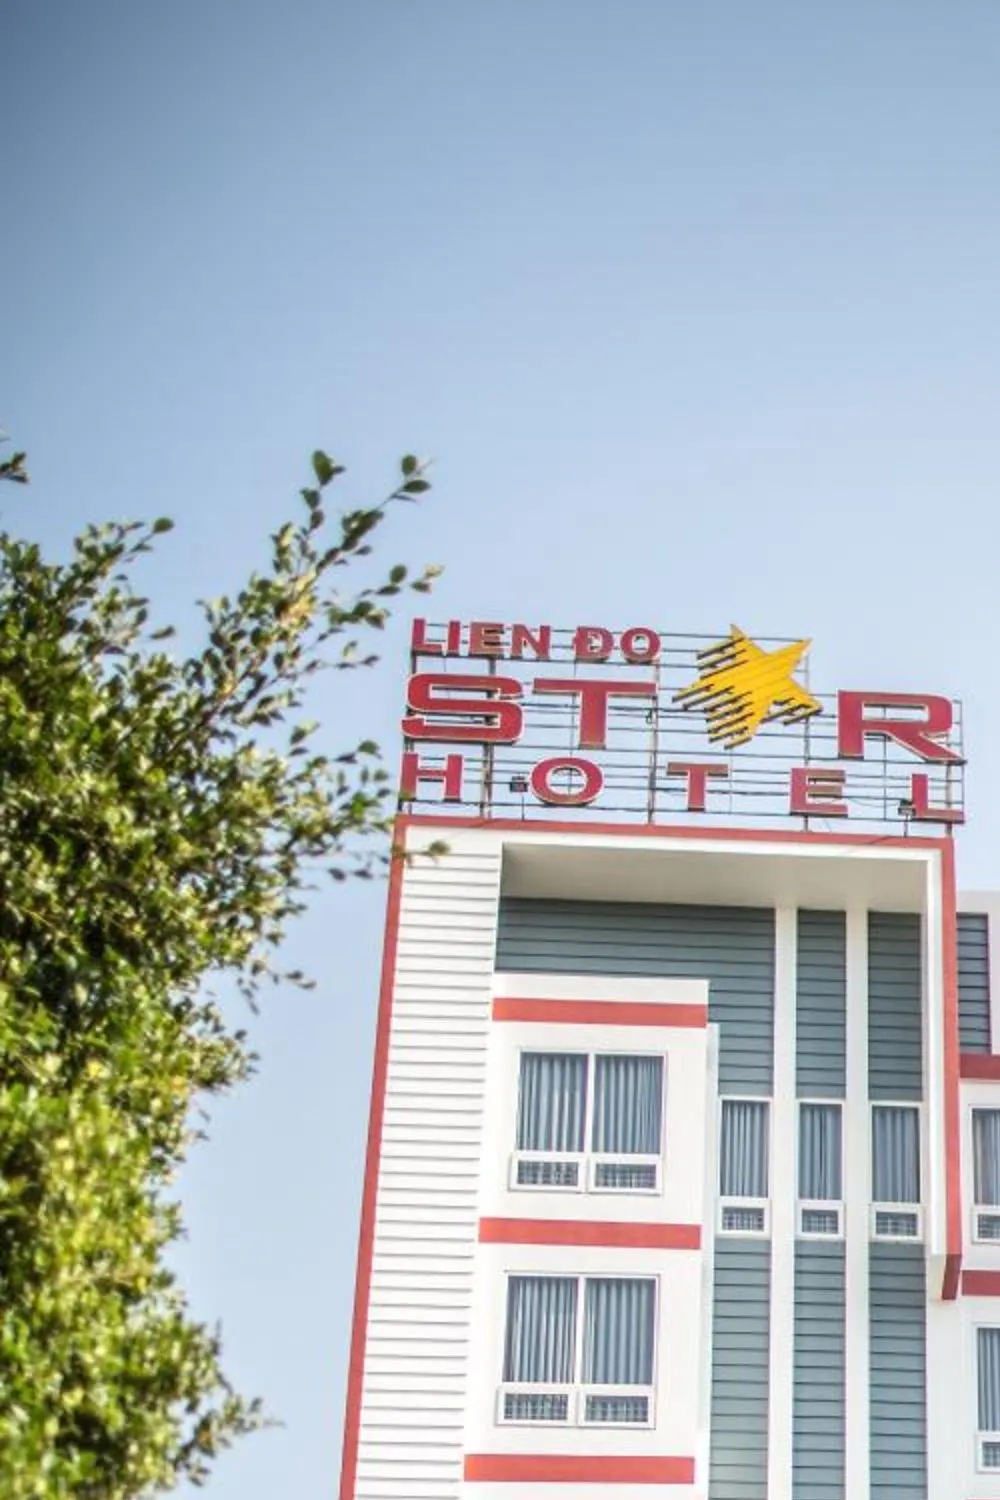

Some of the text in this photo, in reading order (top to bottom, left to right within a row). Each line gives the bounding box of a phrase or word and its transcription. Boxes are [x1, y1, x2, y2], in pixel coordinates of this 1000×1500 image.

[411, 618, 551, 660] LIEN
[401, 671, 967, 764] STR
[400, 752, 966, 824] HOTEL
